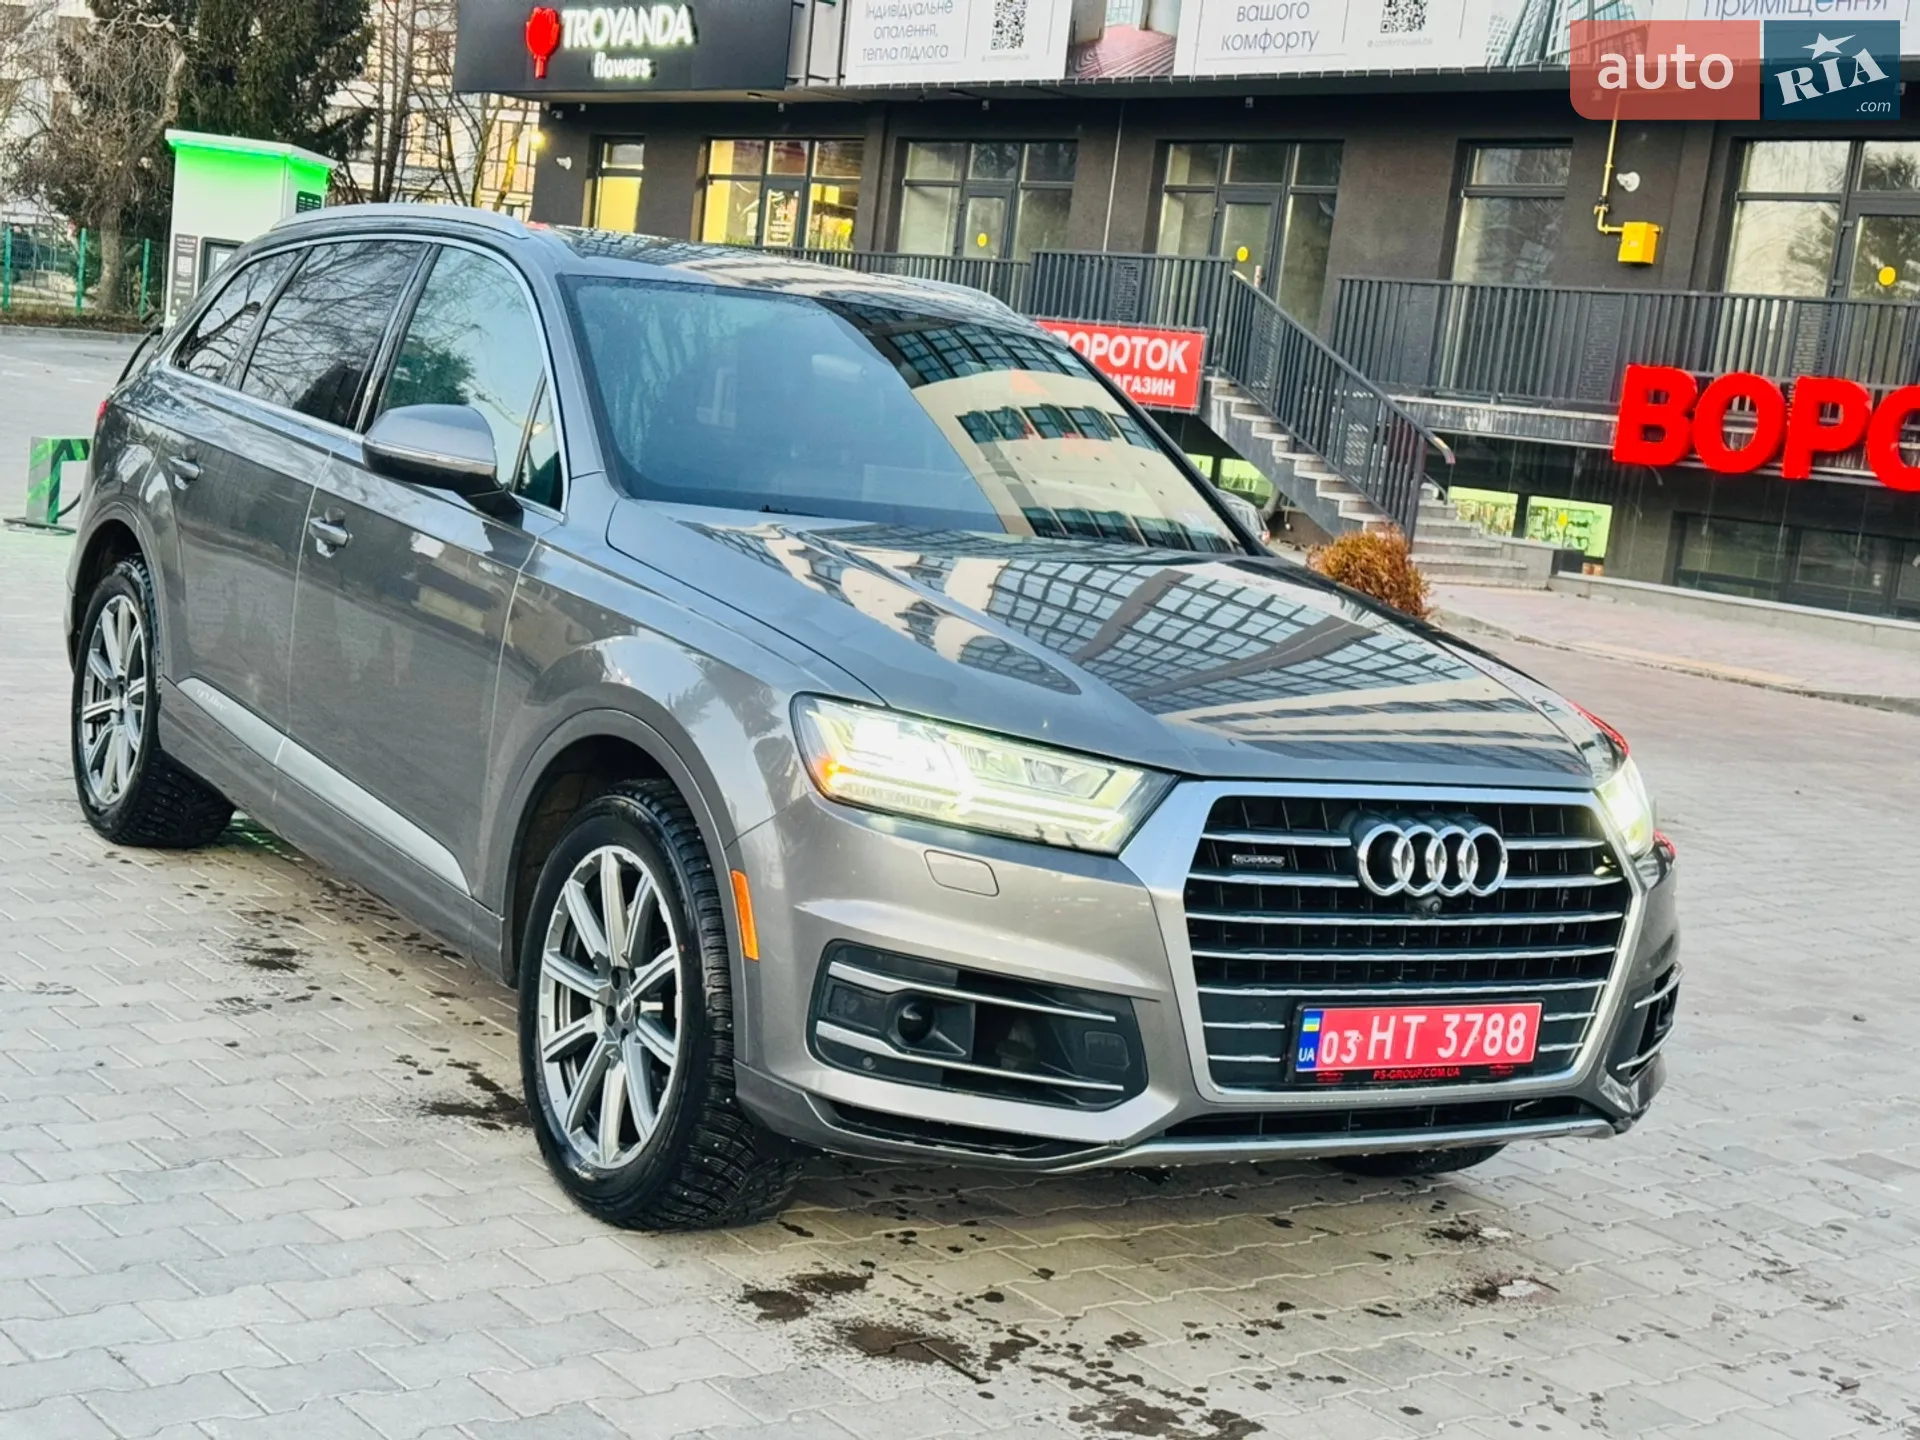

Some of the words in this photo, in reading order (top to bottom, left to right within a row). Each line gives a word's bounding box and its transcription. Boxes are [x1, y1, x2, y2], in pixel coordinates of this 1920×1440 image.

[1236, 2, 1310, 22] вашого
[561, 4, 694, 49] TROYANDA
[873, 23, 938, 40] опалення,
[1221, 28, 1319, 53] комфорту
[862, 46, 898, 61] тепла
[900, 43, 949, 61] підлога
[593, 51, 651, 78] flowers
[1106, 372, 1176, 398] АГАЗИН
[1321, 1029, 1361, 1065] 03
[1367, 1014, 1427, 1061] HT
[1437, 1012, 1528, 1059] 3788
[1298, 1047, 1315, 1063] UA
[1373, 1067, 1460, 1080] PS-GROUP.COM.UA
